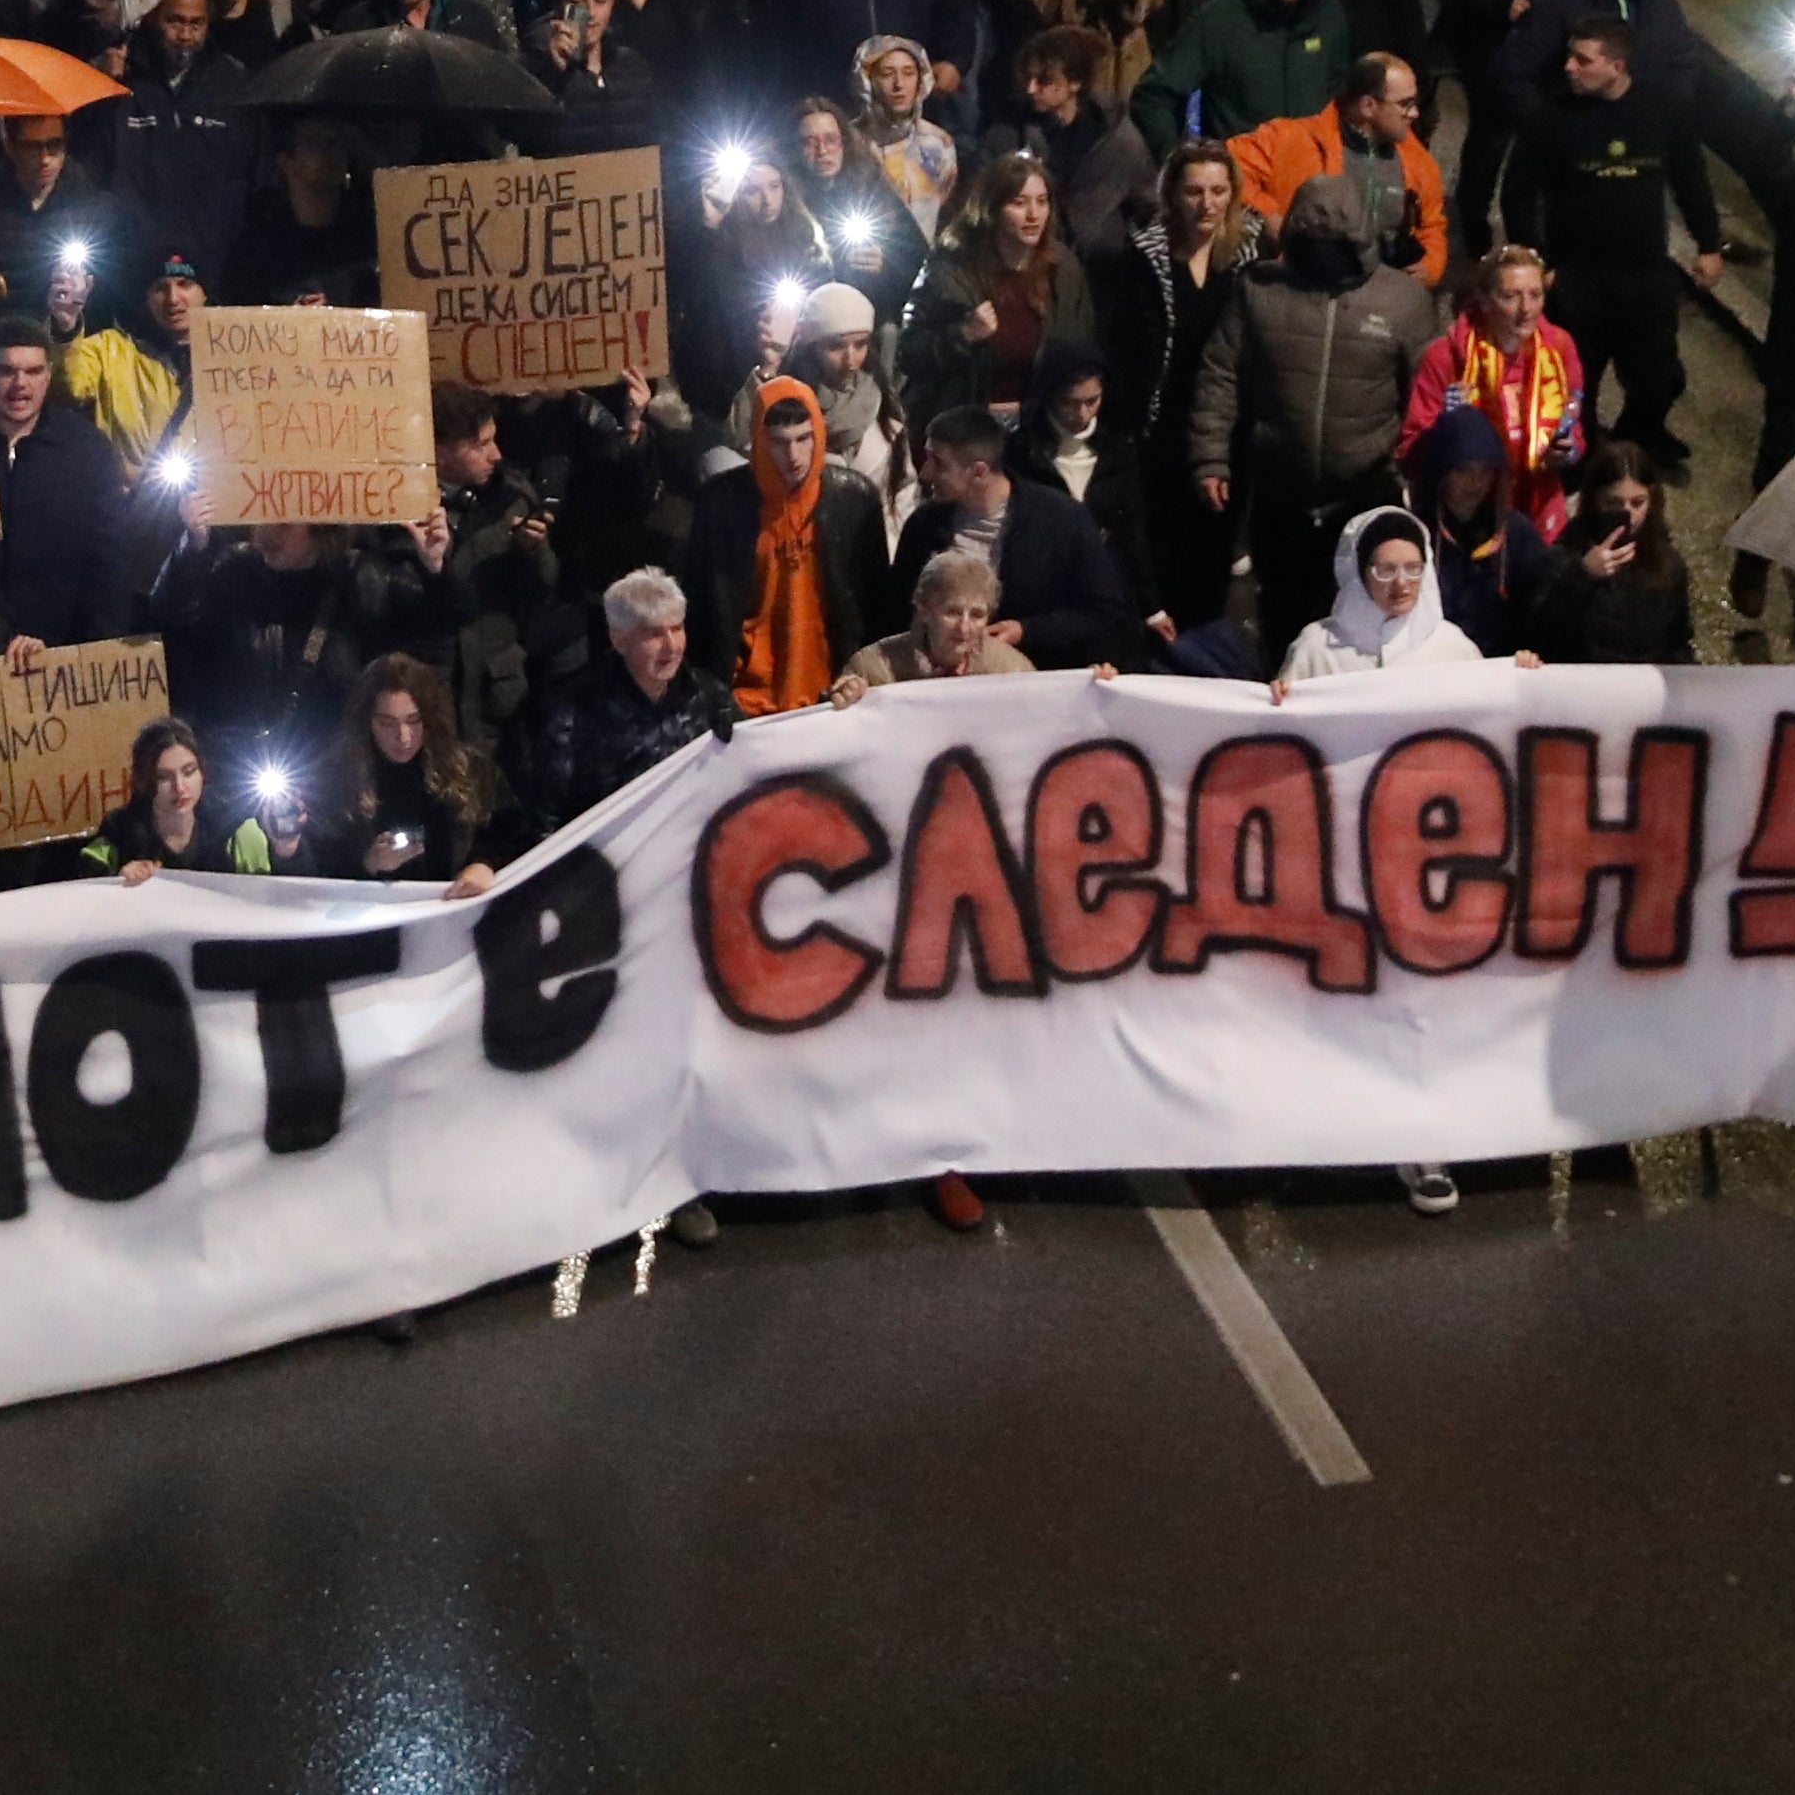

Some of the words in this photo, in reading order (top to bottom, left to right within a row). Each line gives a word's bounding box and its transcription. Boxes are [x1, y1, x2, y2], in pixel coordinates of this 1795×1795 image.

[423, 174, 475, 209] ДА
[493, 169, 577, 208] ЗНАЕ
[433, 283, 519, 326] ДЕКА
[529, 266, 667, 320] СИСТЕМТ
[206, 320, 299, 357] КОЛКУ
[321, 323, 400, 357] МИТО
[459, 310, 651, 386] СЛЕДЕН!
[202, 364, 280, 394] ТРЕБА
[294, 365, 318, 389] ЗА
[326, 368, 357, 396] ДА
[367, 366, 395, 389] ГИ
[216, 401, 404, 456] ВРАТИМЕ
[238, 467, 405, 519] ЖРТВИТЕ?
[10, 656, 168, 714] ТИШИНА
